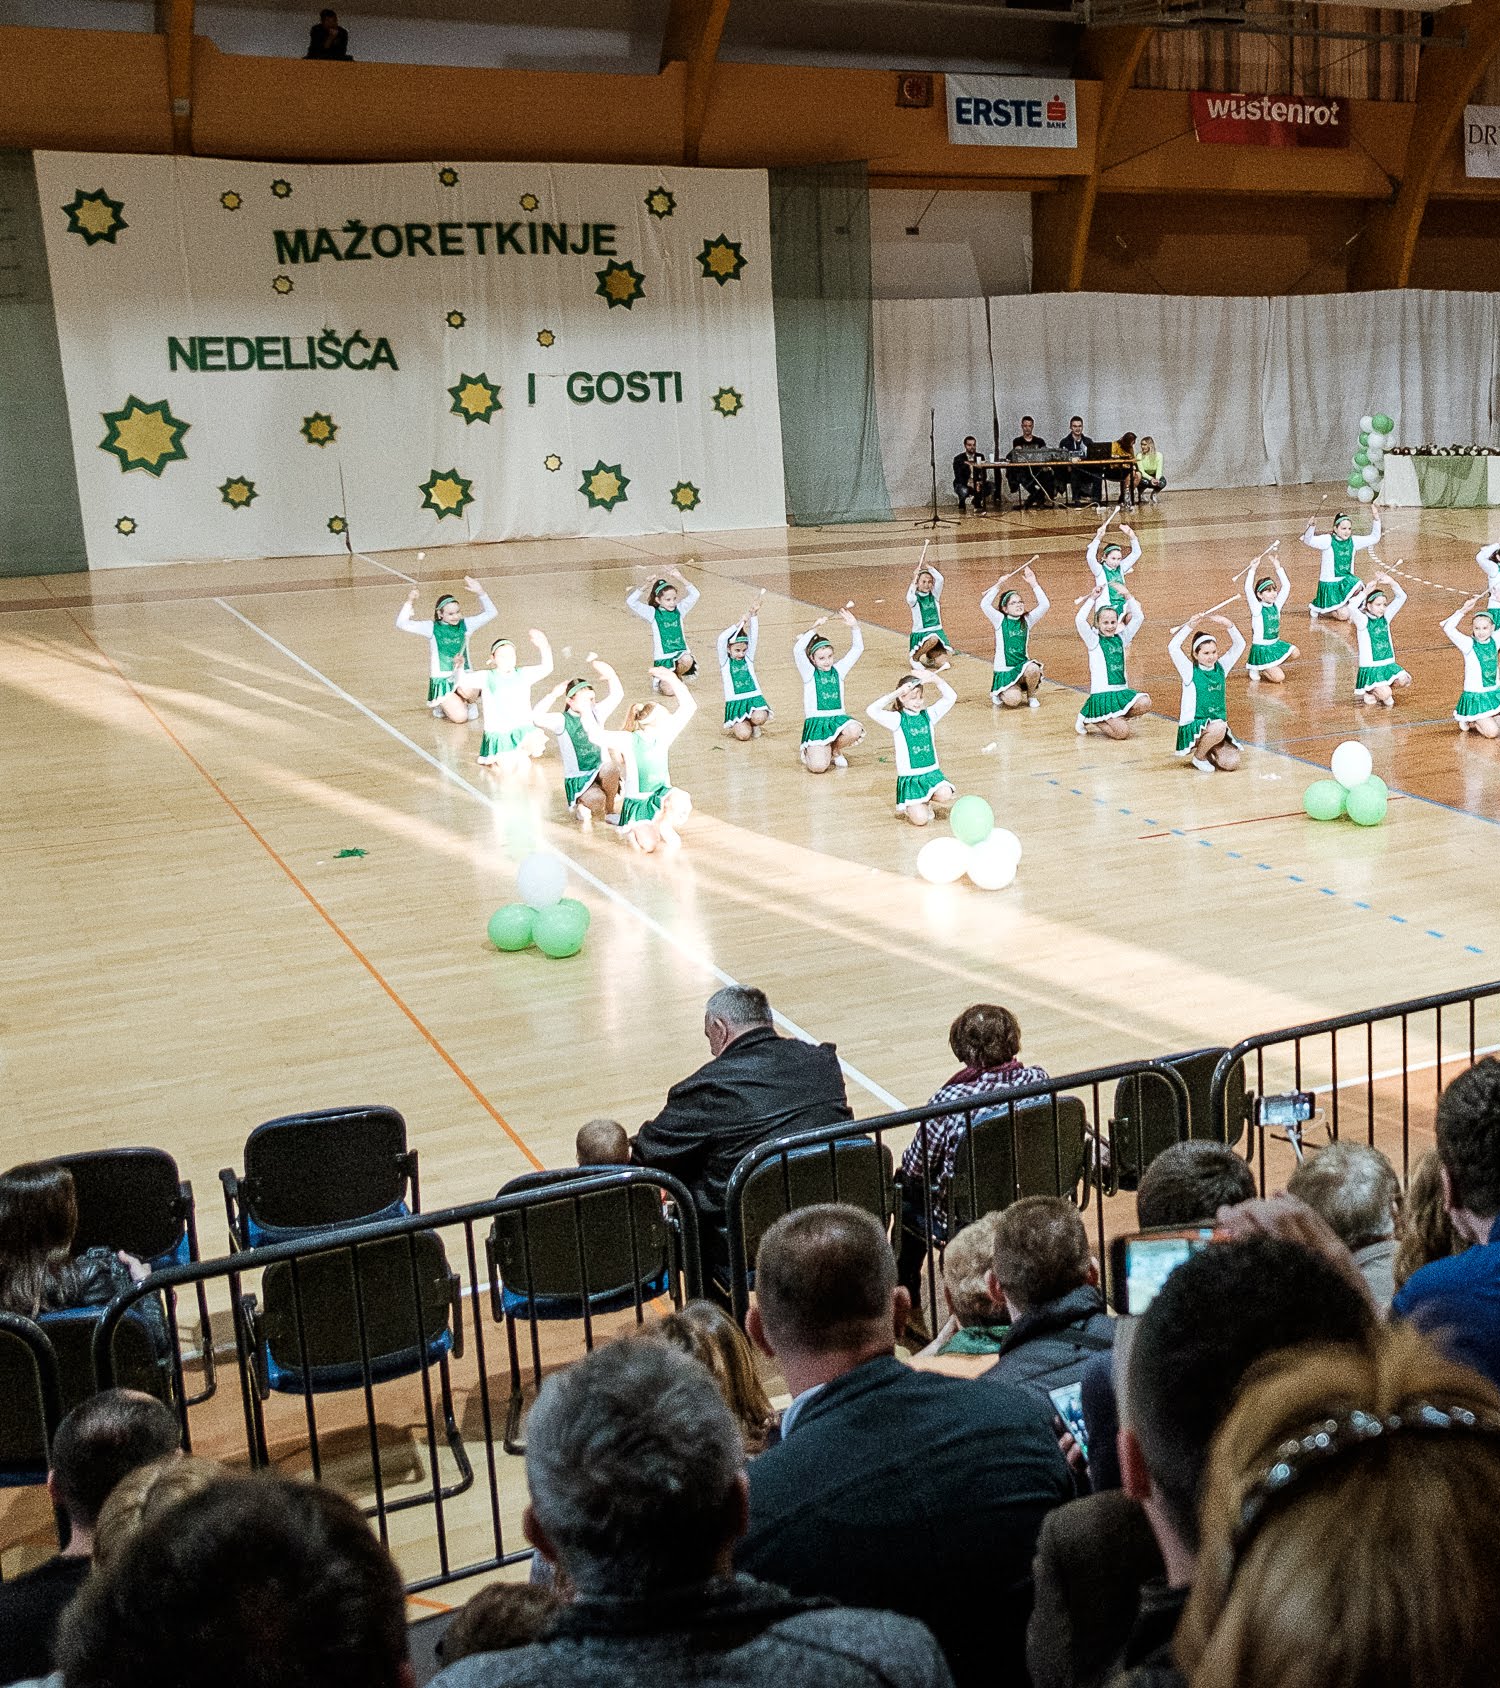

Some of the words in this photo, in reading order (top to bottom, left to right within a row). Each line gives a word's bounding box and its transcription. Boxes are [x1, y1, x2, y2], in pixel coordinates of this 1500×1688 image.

[956, 97, 1042, 128] ERSTE
[273, 220, 618, 265] MAŽORETKINJE
[167, 328, 400, 371] NEDELIŠĆA
[528, 372, 536, 404] I
[566, 371, 683, 404] GOSTI
